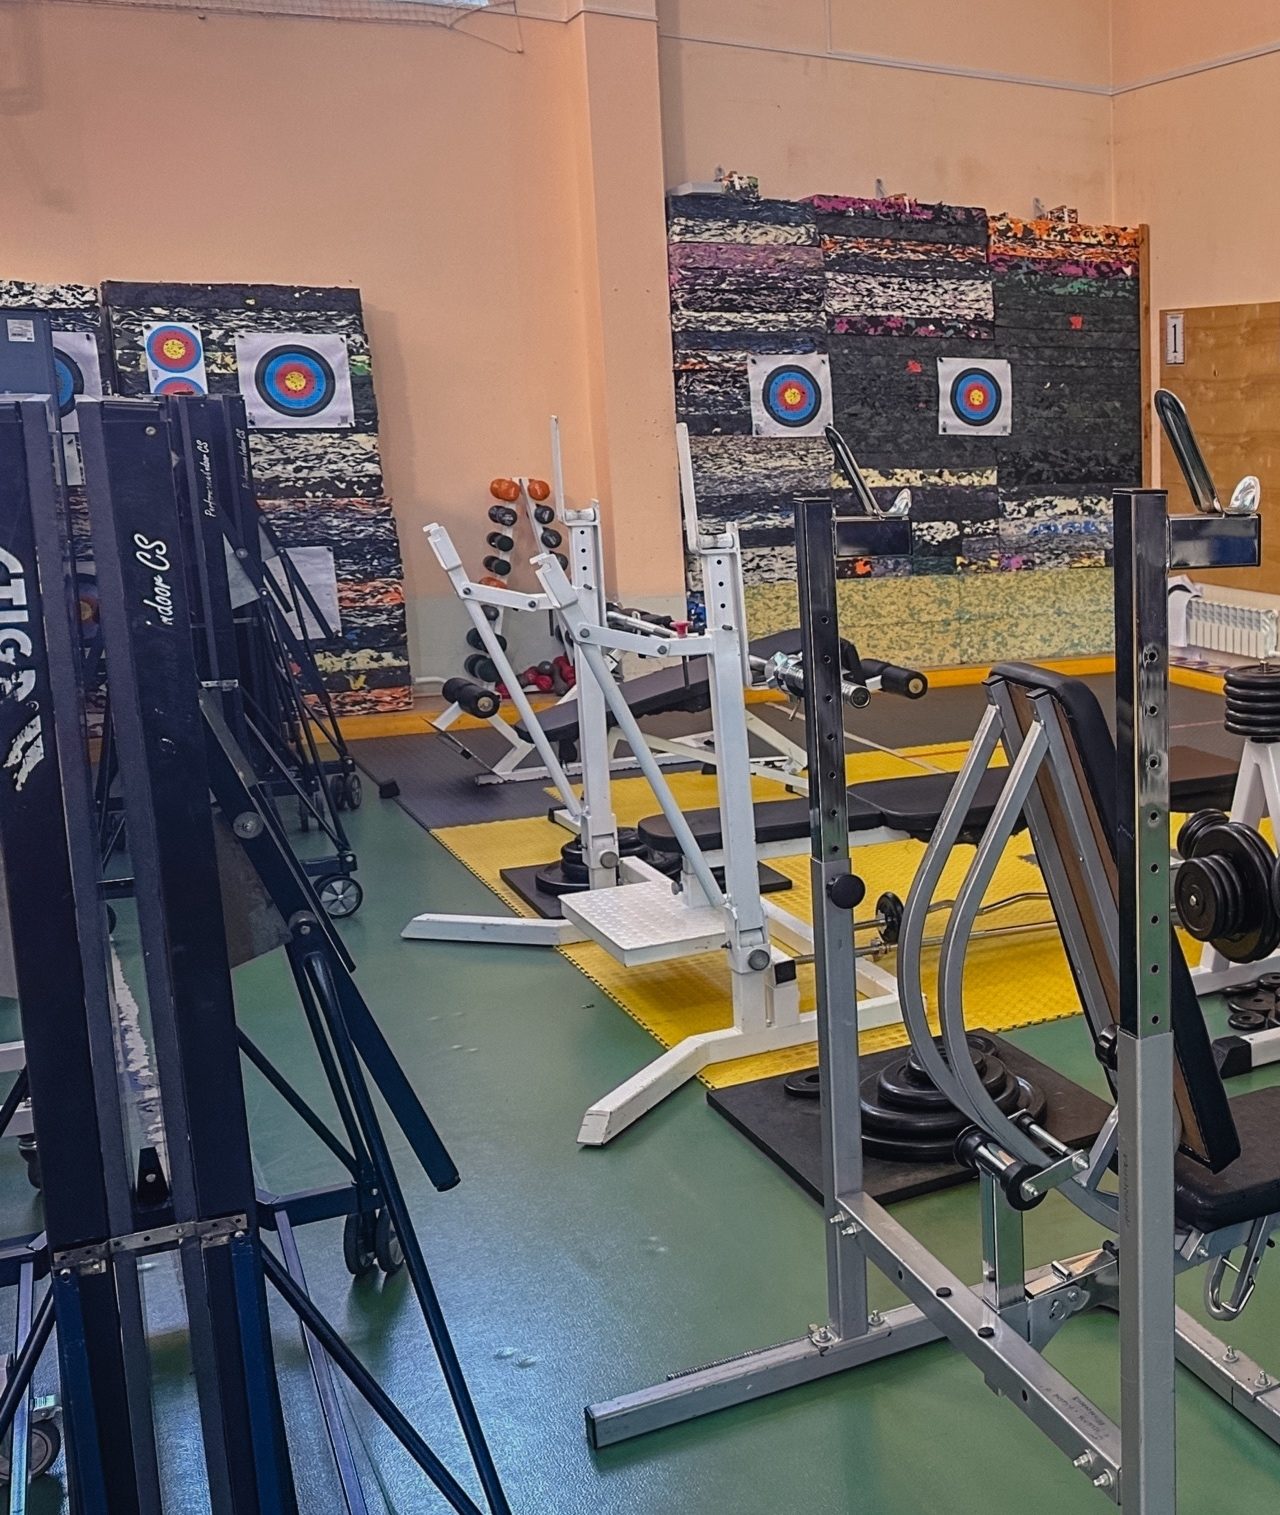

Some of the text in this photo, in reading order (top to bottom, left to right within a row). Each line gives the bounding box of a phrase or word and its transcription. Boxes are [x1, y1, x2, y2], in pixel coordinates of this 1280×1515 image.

[1171, 323, 1179, 353] 1
[133, 533, 174, 626] ndoor CS
